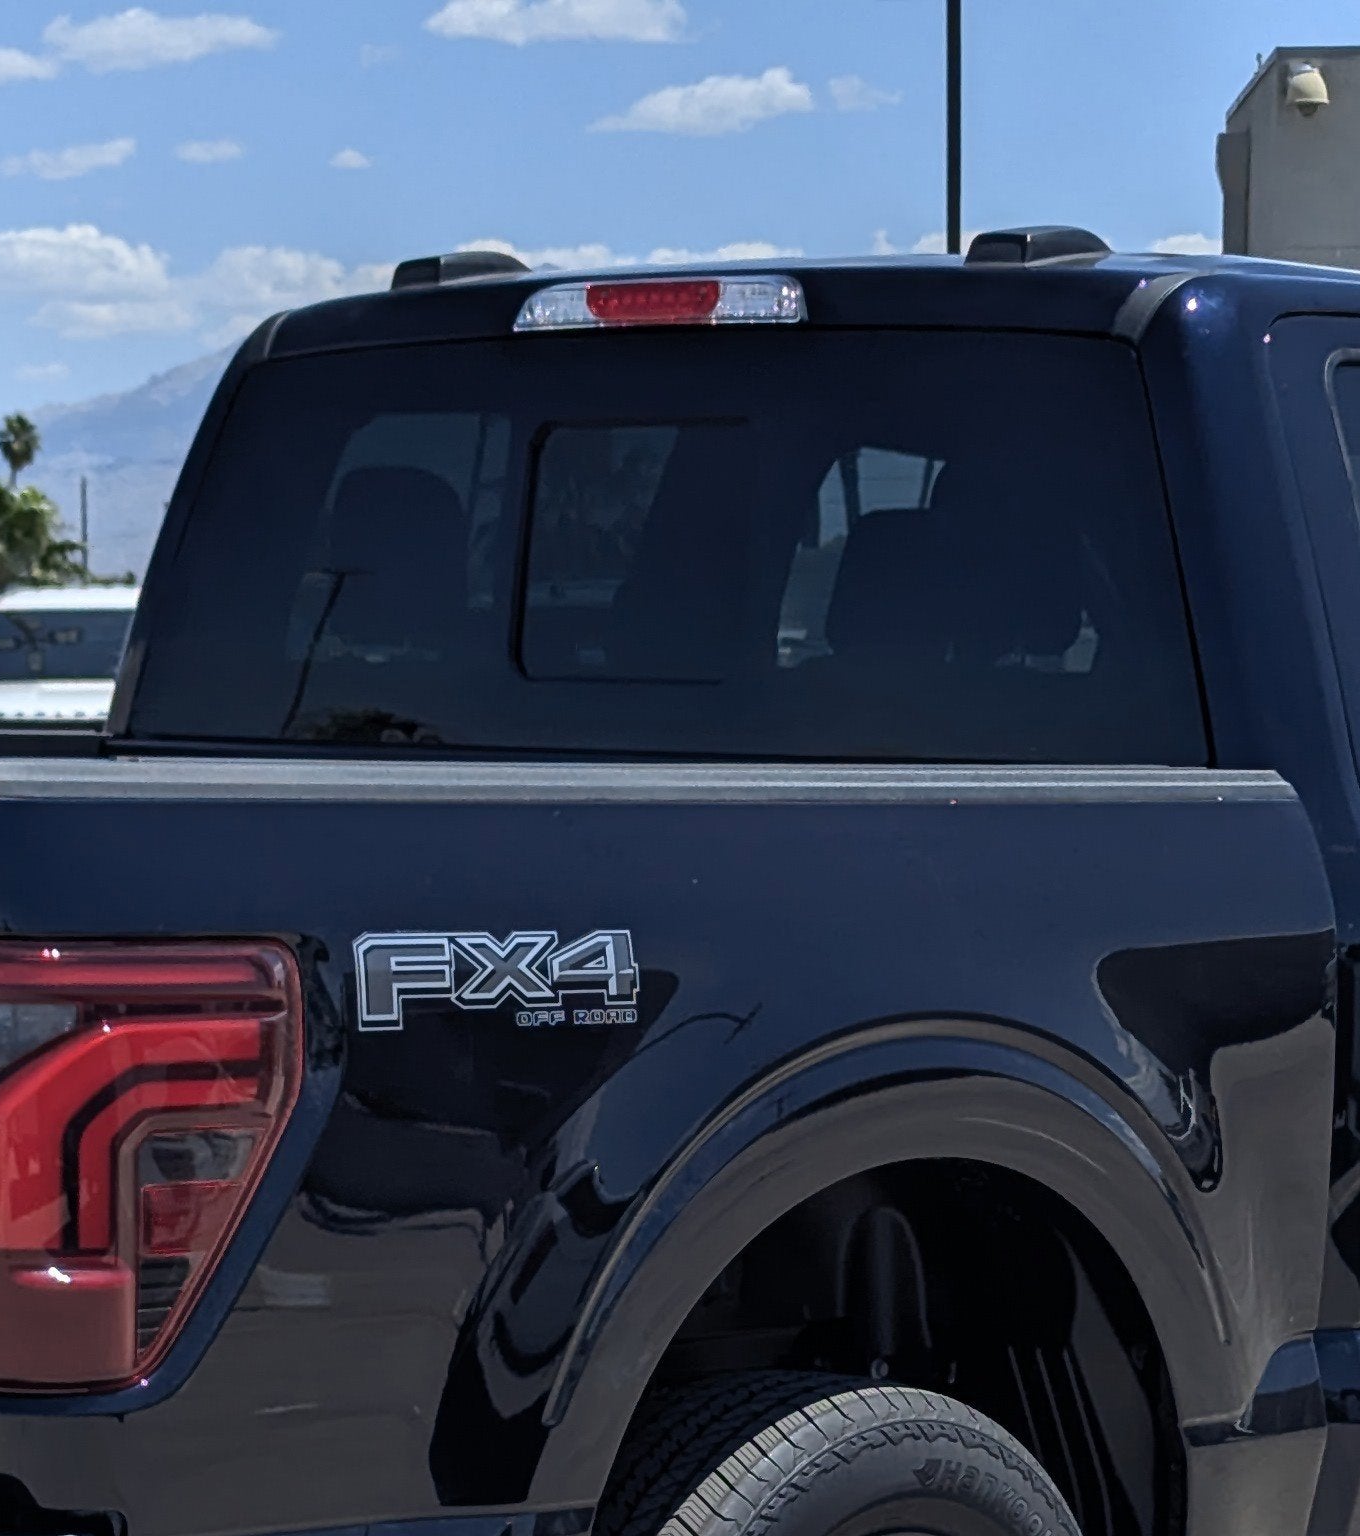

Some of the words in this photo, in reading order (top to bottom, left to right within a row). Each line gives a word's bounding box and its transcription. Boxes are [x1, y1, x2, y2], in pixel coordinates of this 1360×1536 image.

[352, 930, 640, 1031] FX4
[515, 1010, 566, 1026] OFF
[572, 1009, 638, 1025] ROAD
